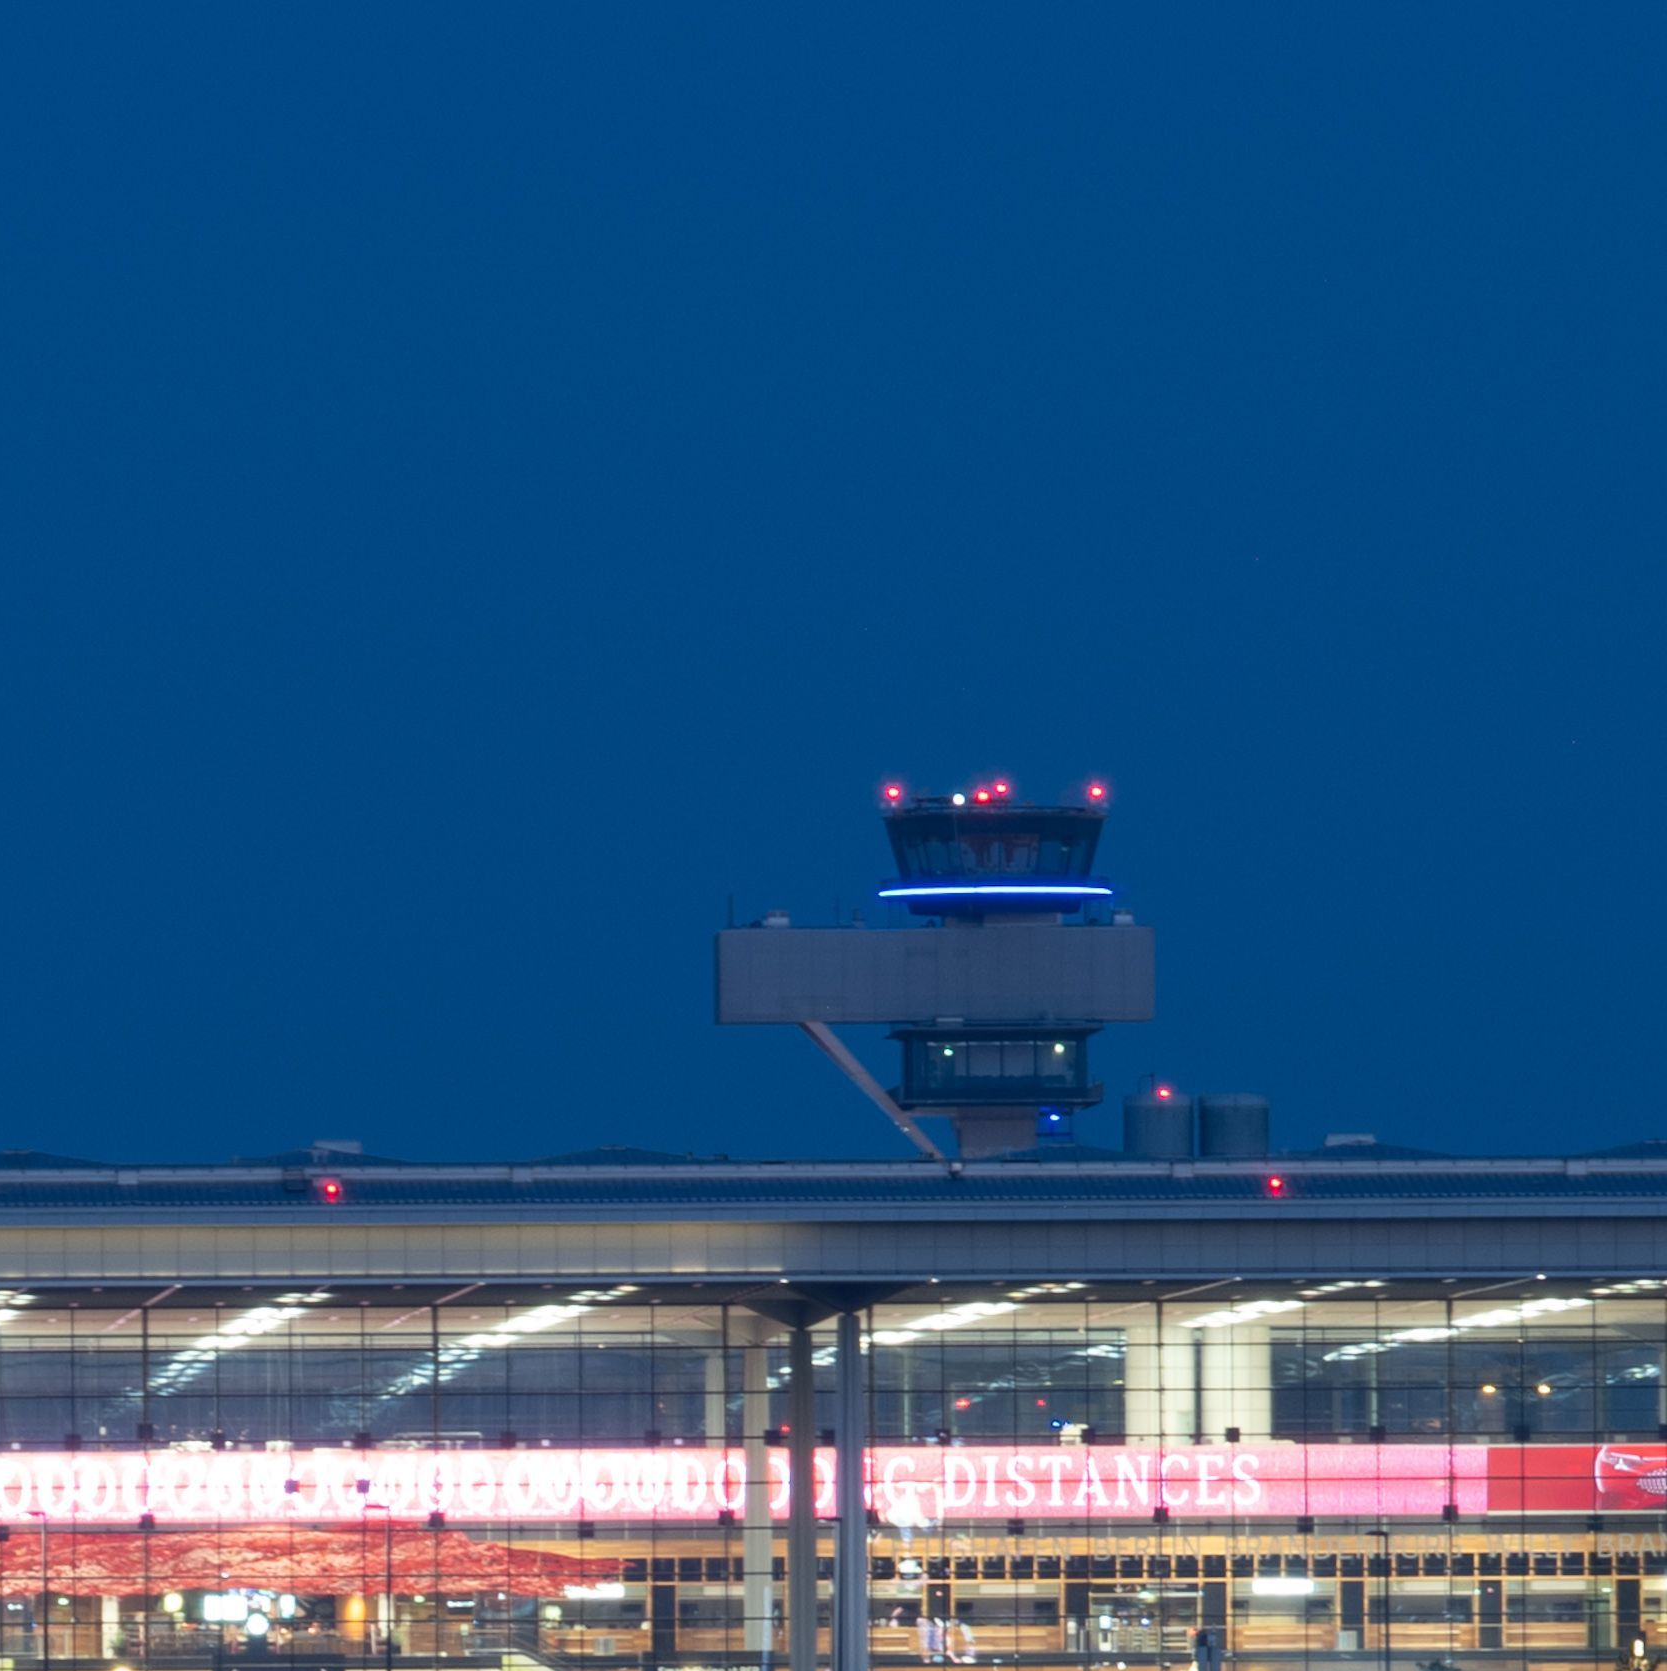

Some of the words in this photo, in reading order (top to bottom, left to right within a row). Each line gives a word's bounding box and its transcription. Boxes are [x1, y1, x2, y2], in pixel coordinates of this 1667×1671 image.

[944, 1454, 1262, 1507] DISTANCES
[1093, 1534, 1201, 1562] BERLIN
[1486, 1533, 1575, 1559] WILLY
